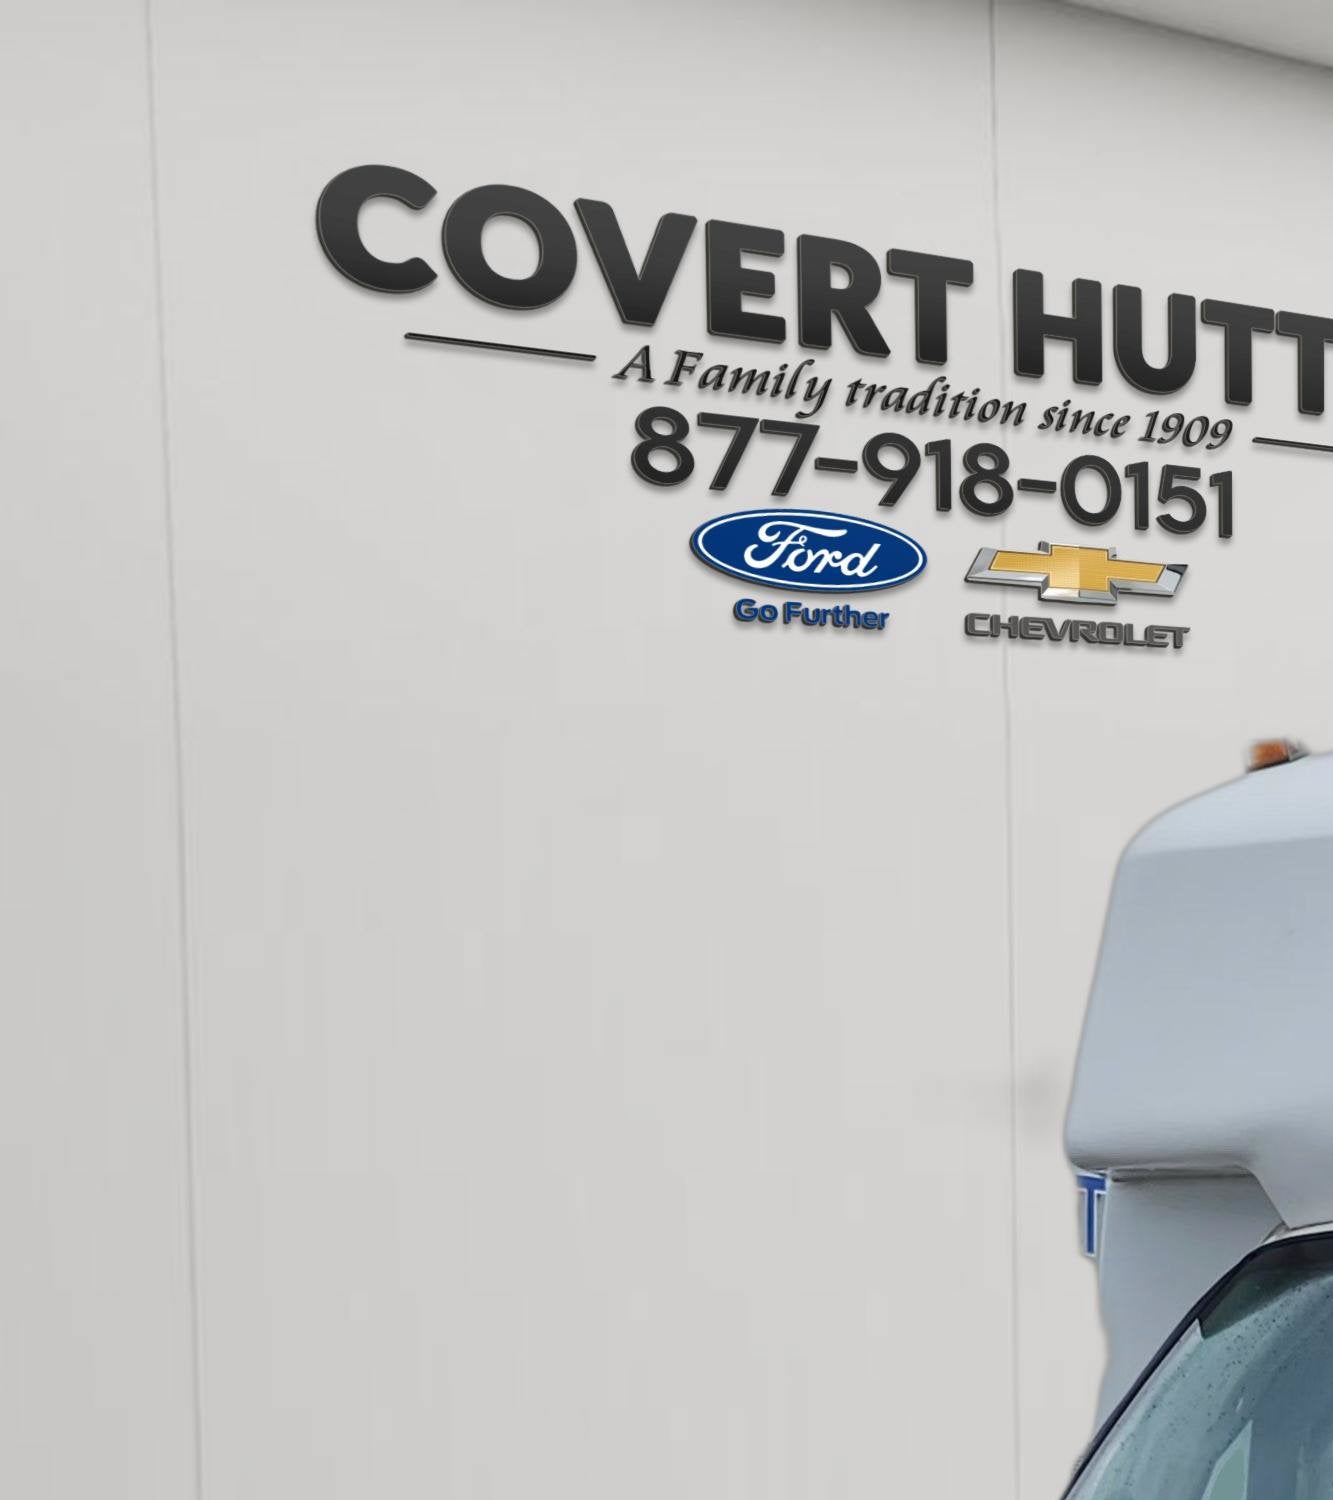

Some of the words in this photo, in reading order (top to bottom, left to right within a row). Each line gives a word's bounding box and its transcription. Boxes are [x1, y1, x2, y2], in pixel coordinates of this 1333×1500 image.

[316, 165, 974, 367] COVERT
[613, 345, 655, 384] A
[664, 350, 832, 419] Family
[846, 376, 1028, 427] tradition
[1037, 405, 1131, 439] since
[1138, 411, 1234, 451] 1909
[631, 407, 1233, 540] 877-918-0151
[743, 519, 882, 580] Ford
[733, 598, 779, 626] Go
[783, 602, 890, 631] Further
[964, 613, 1190, 650] CHEVROLET
